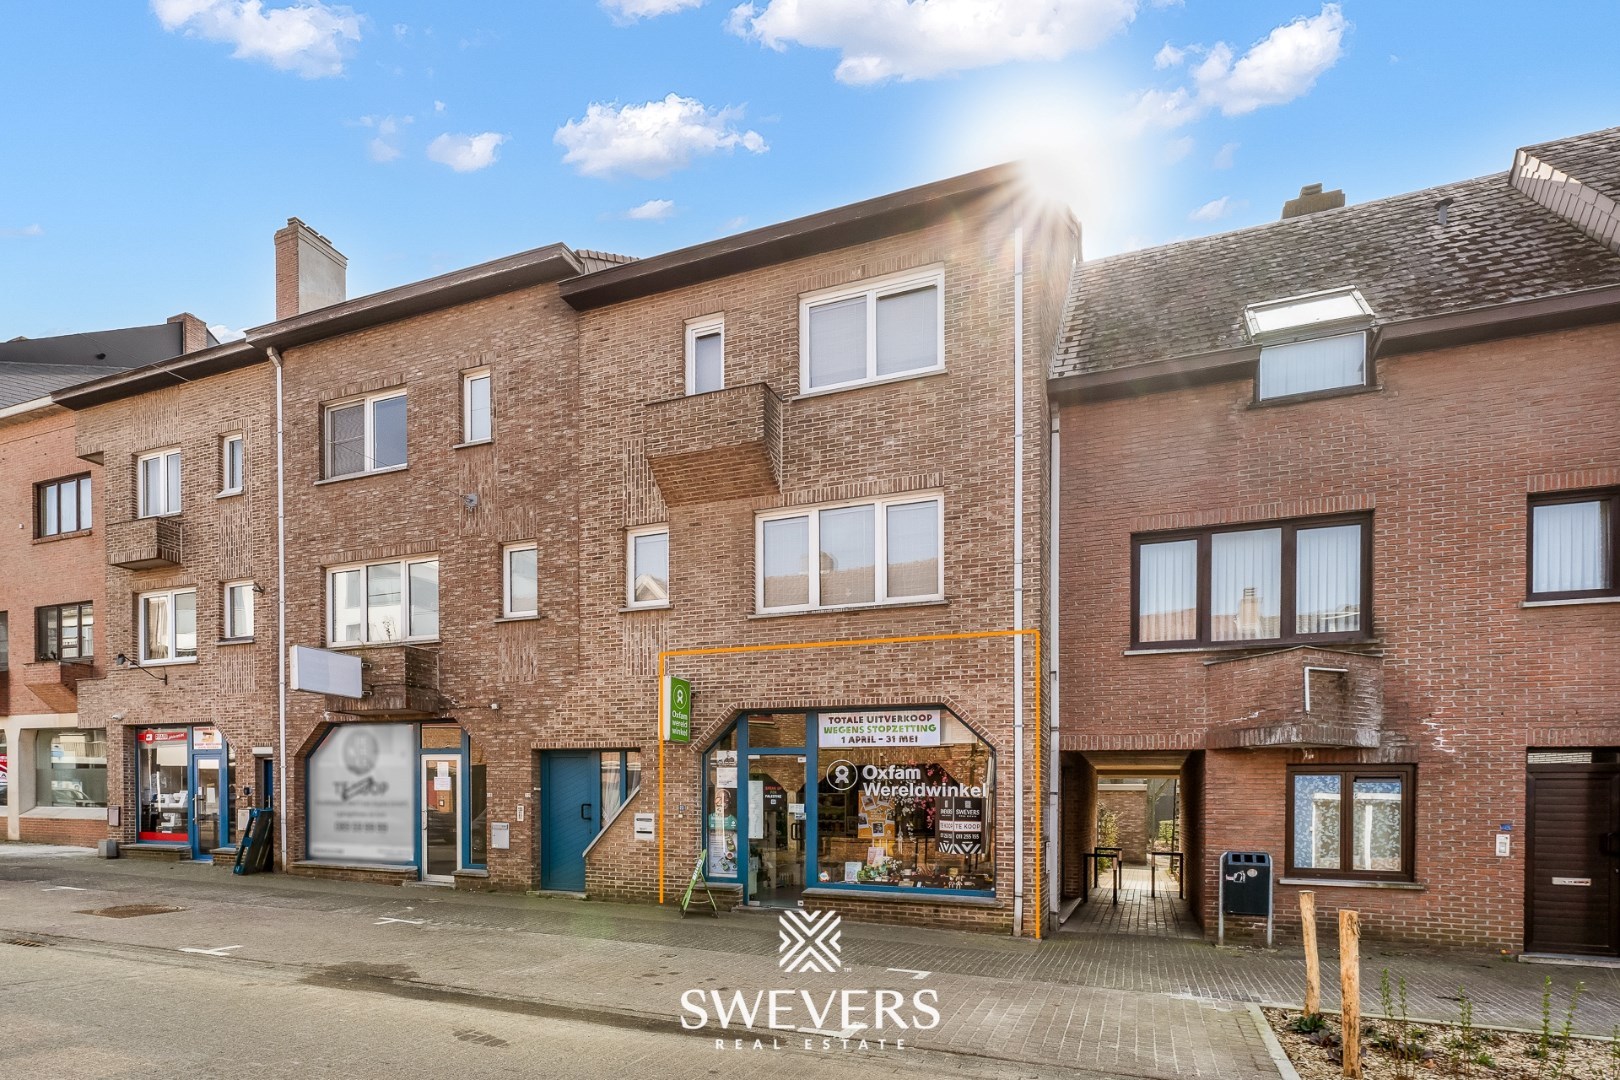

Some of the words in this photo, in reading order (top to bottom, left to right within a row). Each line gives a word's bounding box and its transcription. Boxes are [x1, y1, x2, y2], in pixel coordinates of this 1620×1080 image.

[672, 710, 688, 720] Oxfam
[828, 715, 864, 724] TOTALE
[866, 713, 933, 723] UITVERKOOP
[823, 726, 865, 734] WEGENS
[867, 723, 937, 733] STOPZETTING
[848, 735, 876, 744] APRIL
[885, 735, 896, 743] 31
[899, 735, 918, 743] MEI
[862, 764, 921, 780] Oxfam
[862, 782, 986, 798] Wereldwinkel
